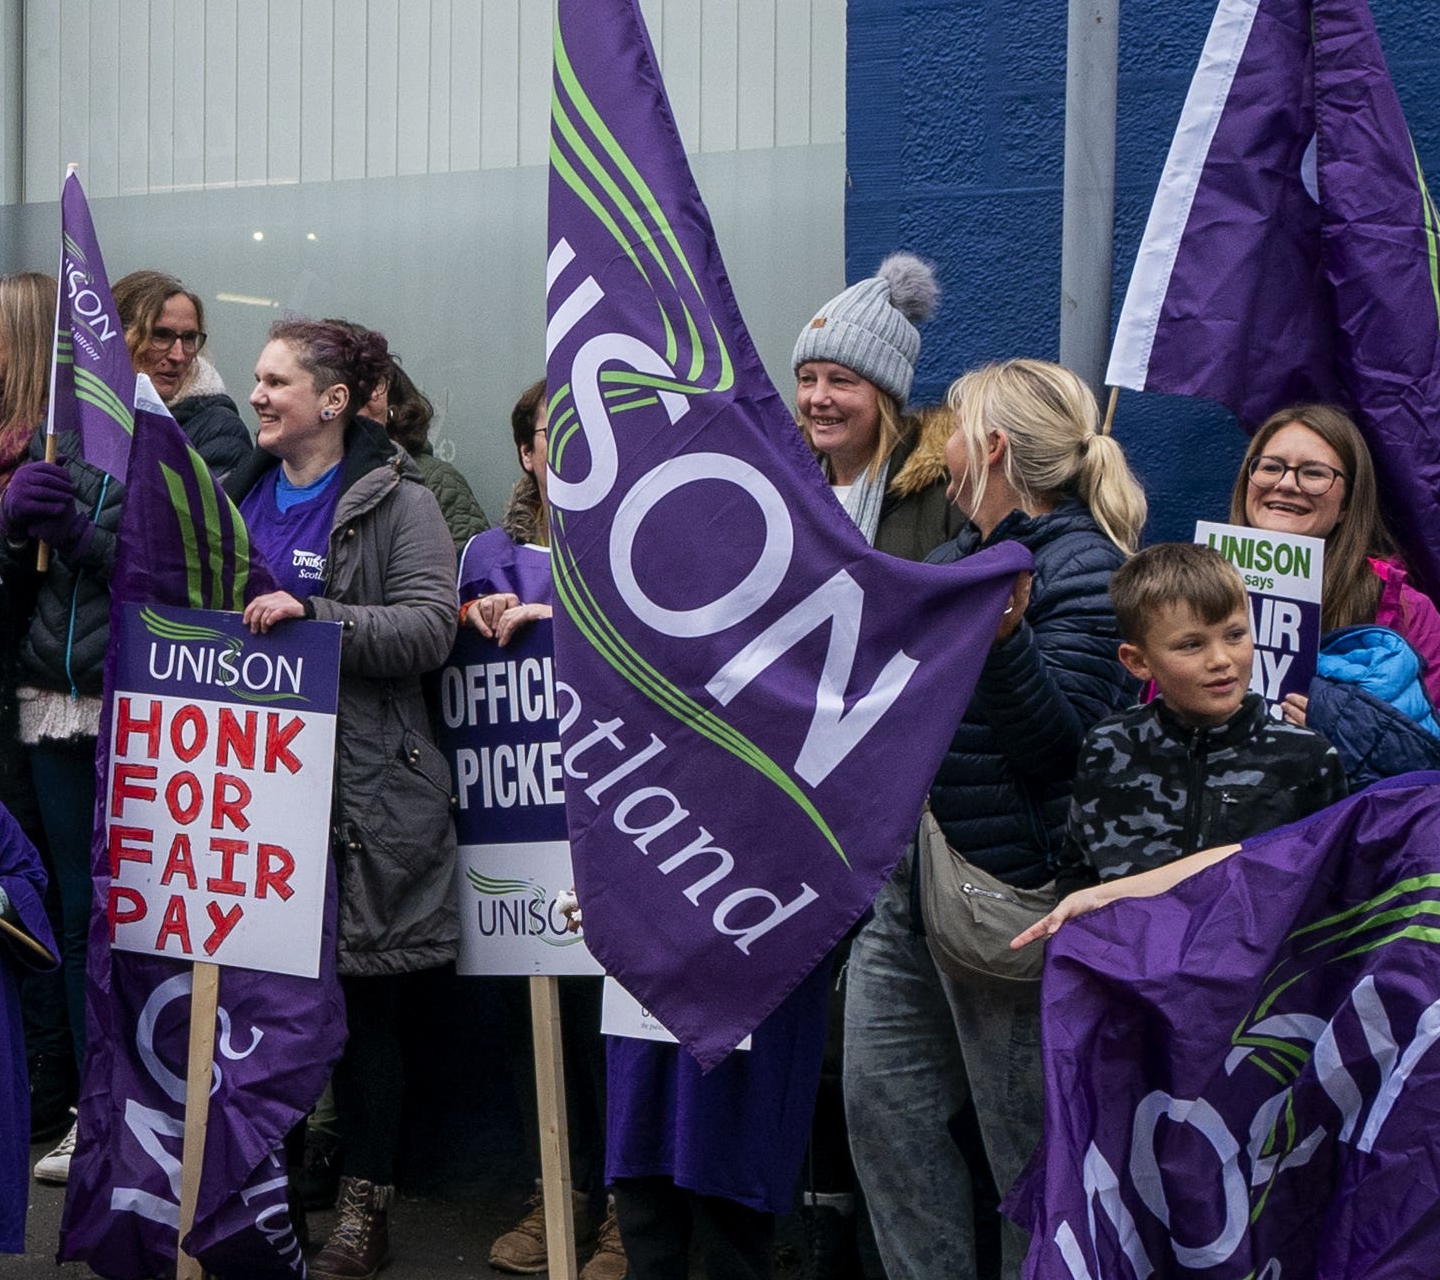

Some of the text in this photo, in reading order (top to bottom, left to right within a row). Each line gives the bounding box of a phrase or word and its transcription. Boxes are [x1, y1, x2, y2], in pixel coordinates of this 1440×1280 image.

[74, 331, 101, 361] union
[1244, 573, 1274, 591] says
[148, 641, 305, 696] UNISON
[441, 657, 558, 730] OFFICI
[114, 695, 307, 777] HONK
[112, 764, 253, 833] FOR
[456, 741, 565, 810] PICKE
[556, 679, 820, 957] otland
[110, 825, 297, 903] FAIR
[108, 886, 244, 959] PAY
[478, 898, 570, 936] UNISO
